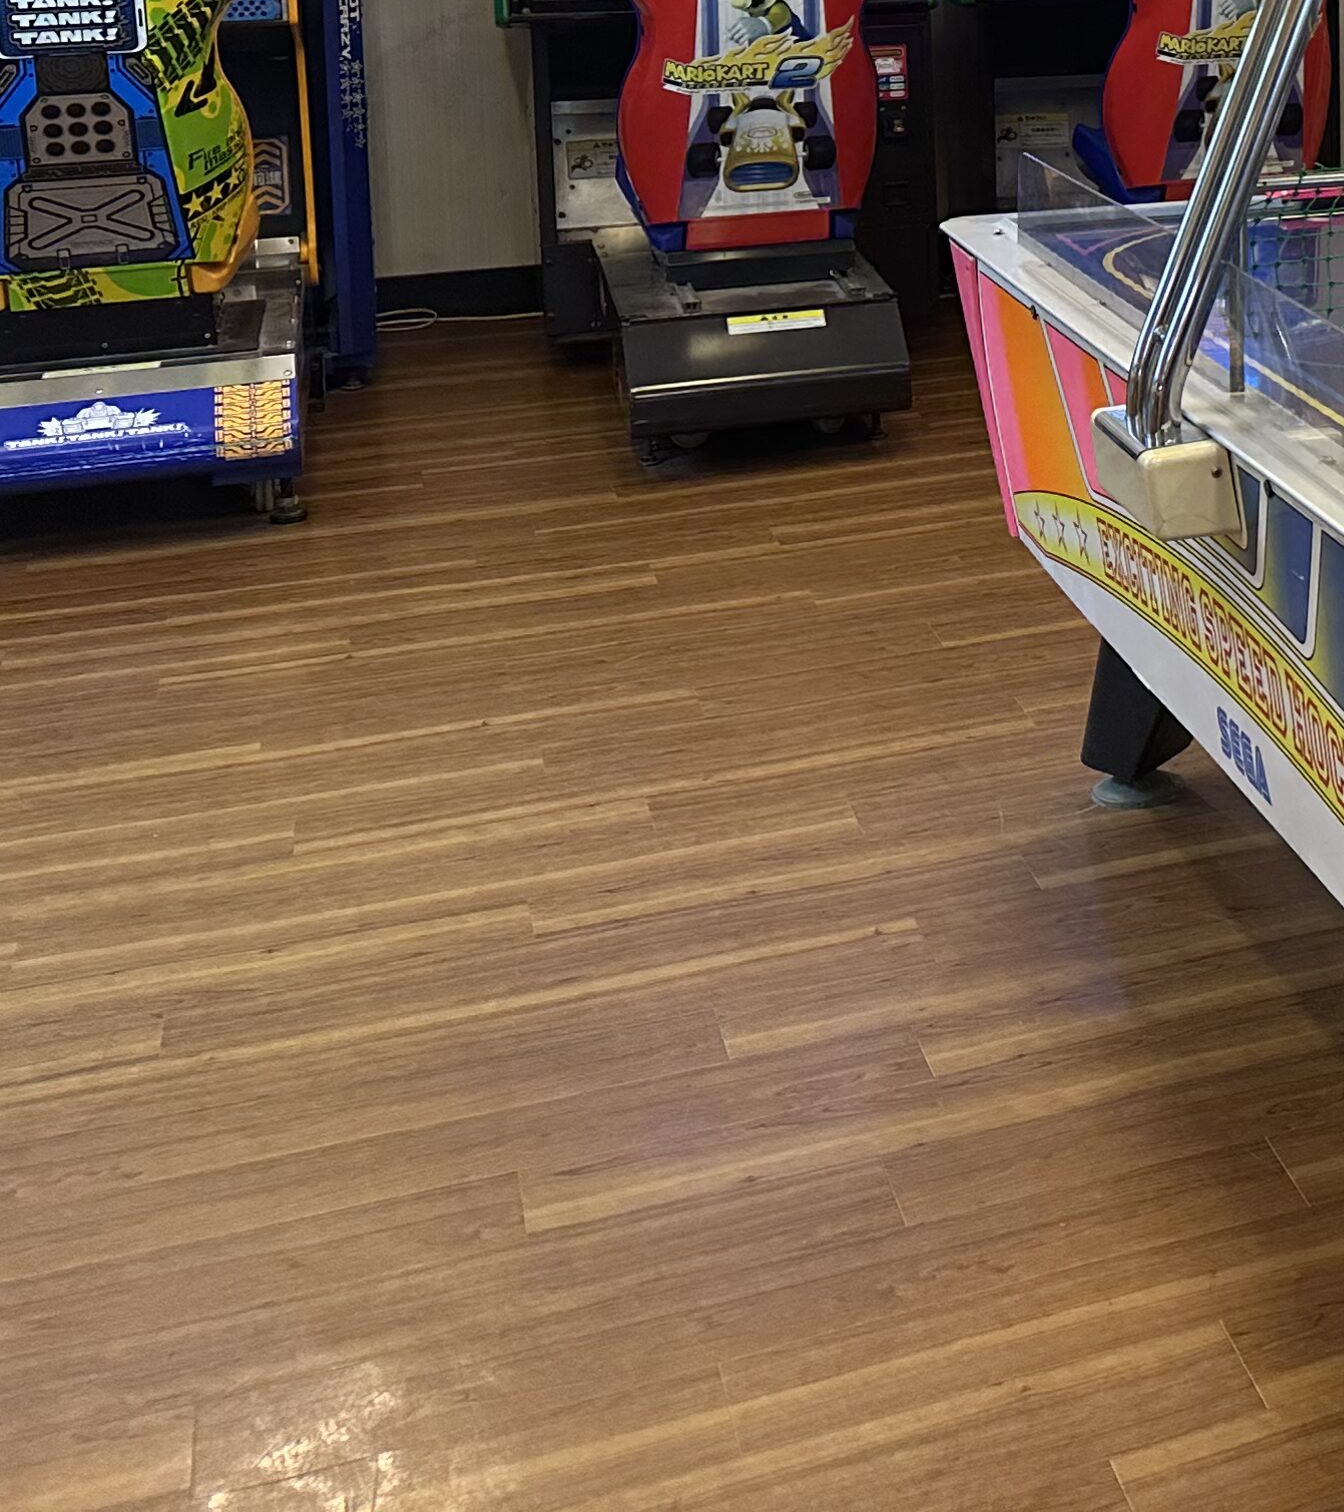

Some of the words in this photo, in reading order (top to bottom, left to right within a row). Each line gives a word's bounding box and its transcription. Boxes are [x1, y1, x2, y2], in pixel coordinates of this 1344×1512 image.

[11, 10, 116, 27] TANK!
[13, 28, 118, 45] TANK!
[770, 56, 824, 88] 2
[188, 144, 222, 170] Fire
[1096, 517, 1201, 653] EXCITING
[1200, 589, 1287, 738] SPEED
[1217, 705, 1273, 807] SEGA
